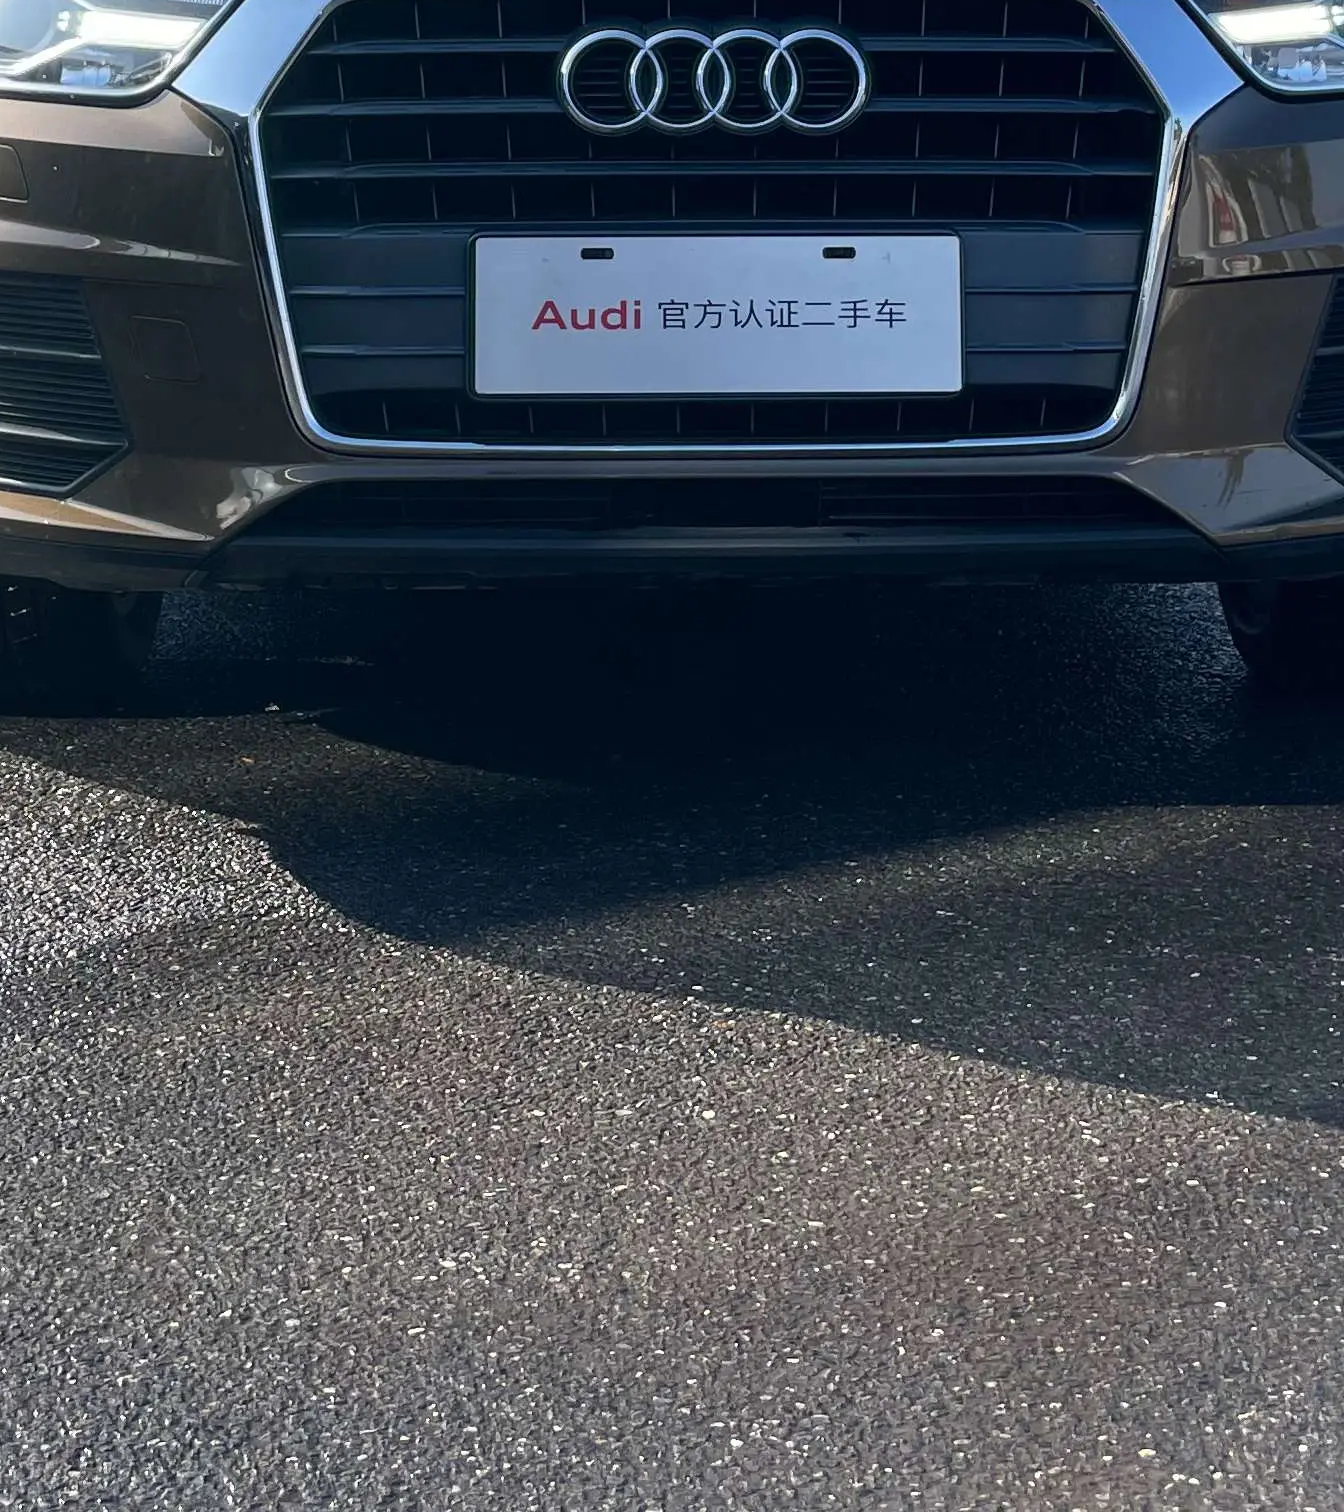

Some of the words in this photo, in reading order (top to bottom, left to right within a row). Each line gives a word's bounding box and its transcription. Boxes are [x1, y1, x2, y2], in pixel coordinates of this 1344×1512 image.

[531, 300, 641, 331] Audi
[658, 299, 908, 330] 官方认证二手车
